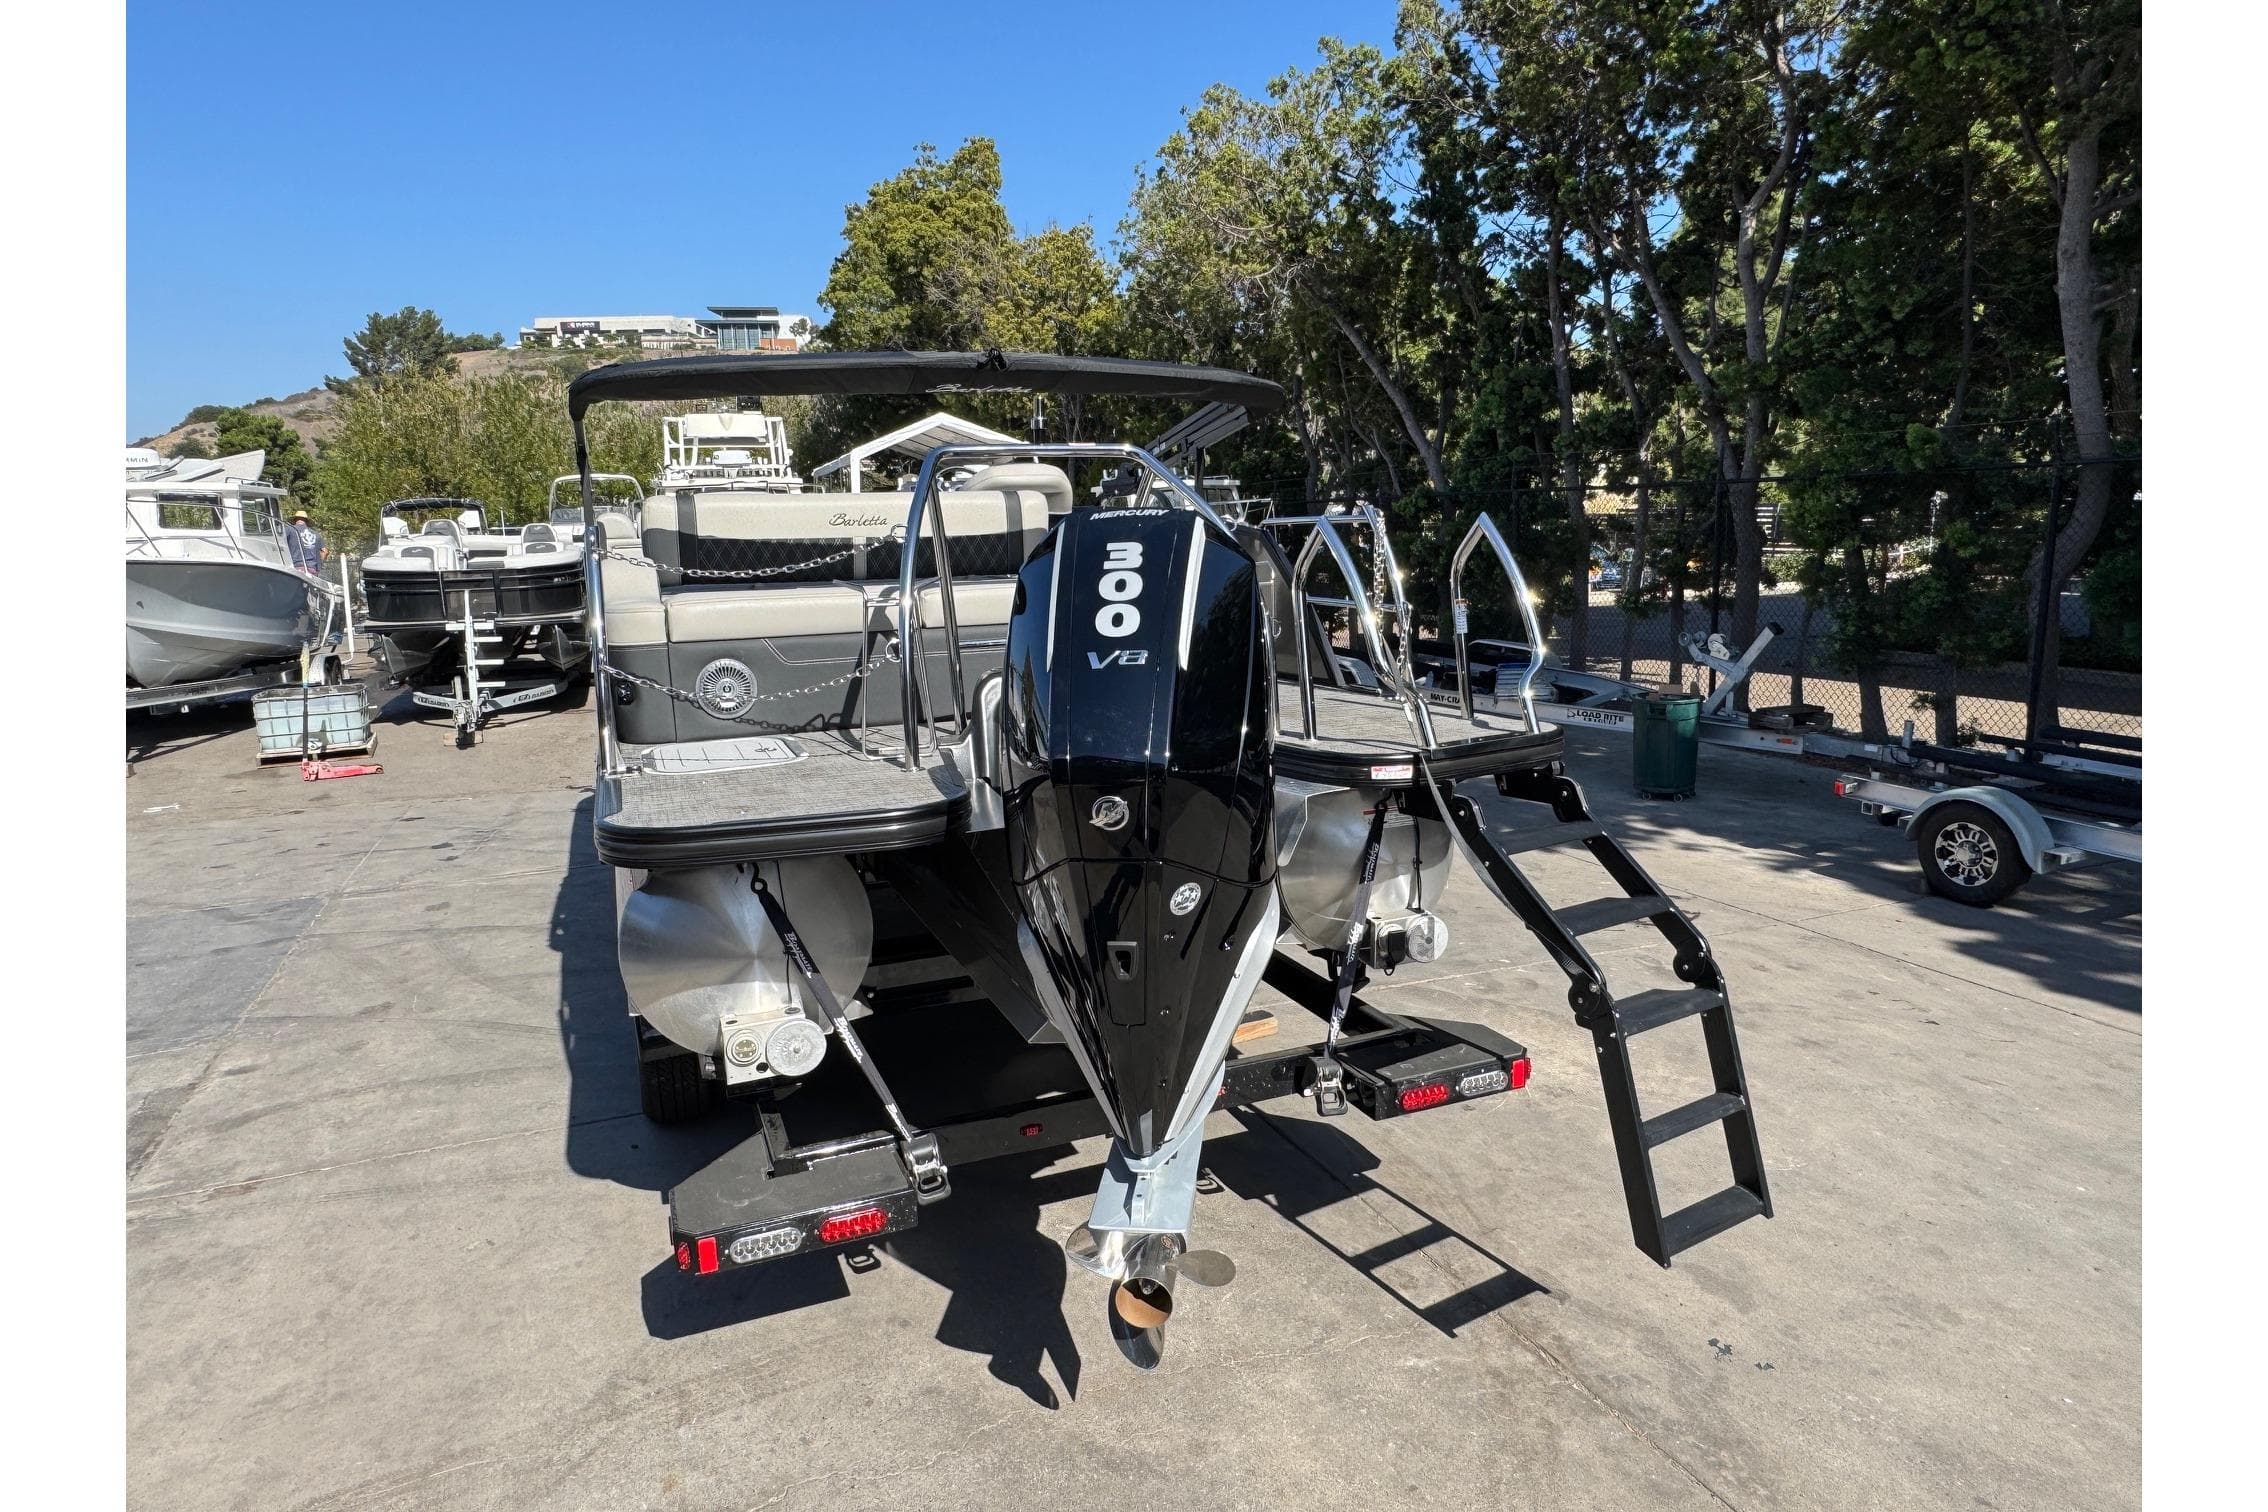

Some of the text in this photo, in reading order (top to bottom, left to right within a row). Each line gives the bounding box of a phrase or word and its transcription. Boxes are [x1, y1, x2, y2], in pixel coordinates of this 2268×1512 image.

[829, 513, 888, 527] Barletta
[1090, 509, 1170, 520] MERCURY
[1095, 541, 1144, 638] 300
[1087, 650, 1149, 669] V8
[1576, 709, 1602, 719] LOAD
